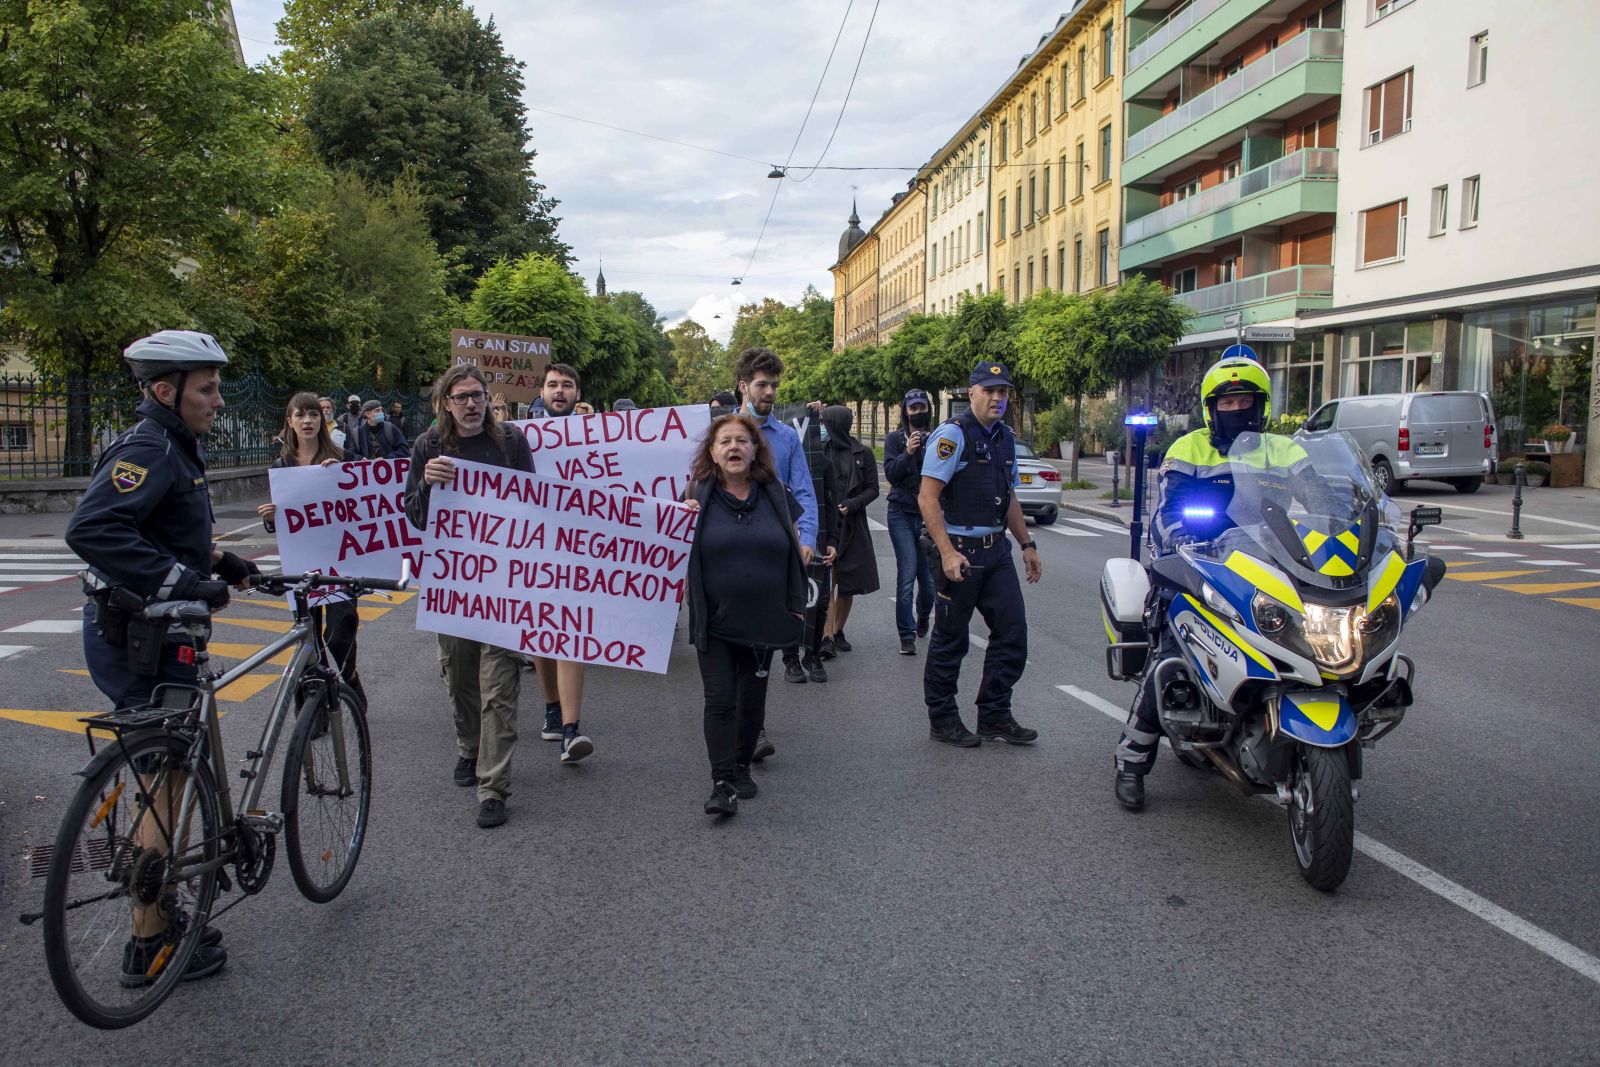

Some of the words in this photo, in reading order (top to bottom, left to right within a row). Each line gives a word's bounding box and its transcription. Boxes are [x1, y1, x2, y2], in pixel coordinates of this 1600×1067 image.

[457, 335, 550, 354] AFGANISTAN
[481, 354, 533, 371] VARNA
[514, 408, 687, 453] OSLEDICA
[338, 459, 411, 490] STOP
[555, 450, 622, 481] VAŠE
[440, 468, 645, 528] HUMANITARNE
[555, 527, 687, 571] NEGATIVOV
[508, 559, 684, 603] PUSHBACKOM
[519, 629, 646, 668] KORIDOR
[1193, 616, 1238, 662] POLICIJA
